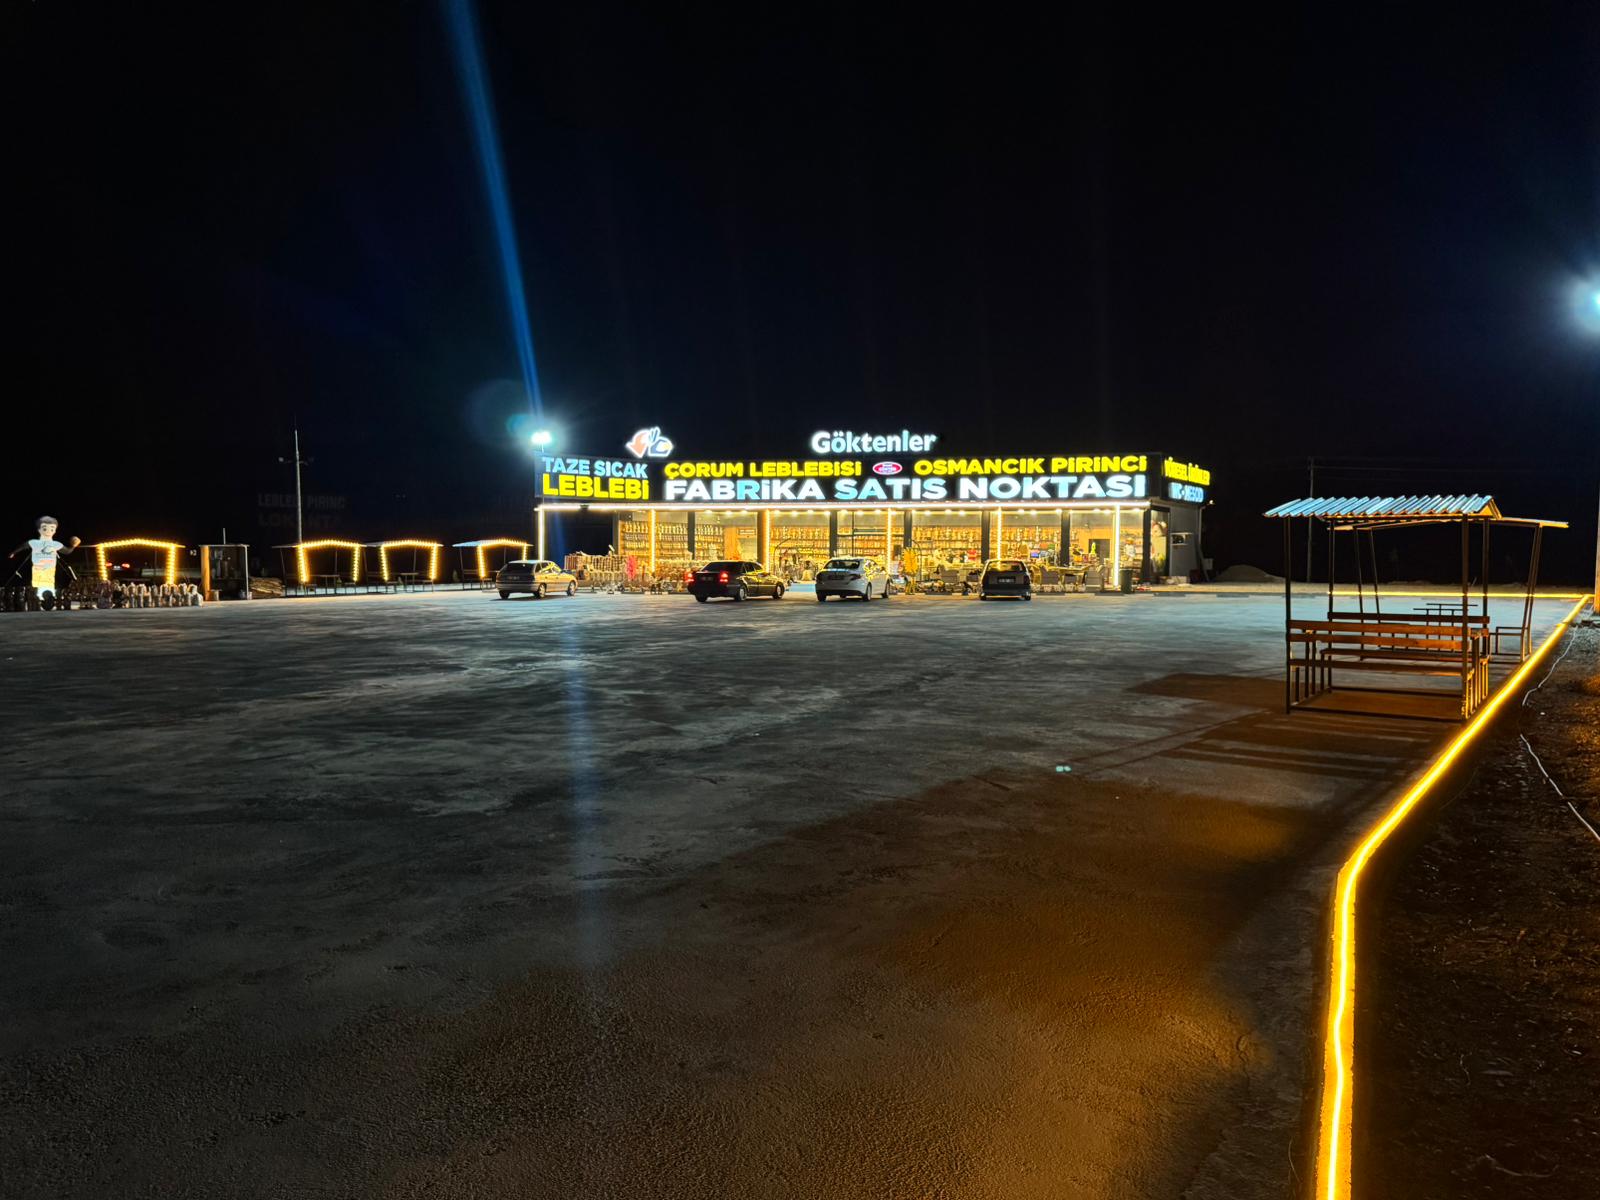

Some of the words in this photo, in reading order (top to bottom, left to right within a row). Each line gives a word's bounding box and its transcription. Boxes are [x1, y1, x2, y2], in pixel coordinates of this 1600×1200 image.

[812, 430, 936, 453] Göktenler
[542, 456, 590, 475] TAZE
[594, 460, 648, 478] SICAK
[664, 462, 744, 479] ÇORUM
[750, 461, 861, 476] LEBLEBİSİ
[914, 458, 1045, 474] OSMANCIK
[665, 479, 825, 500] FABRİKA
[959, 475, 1146, 499] NOKTASI
